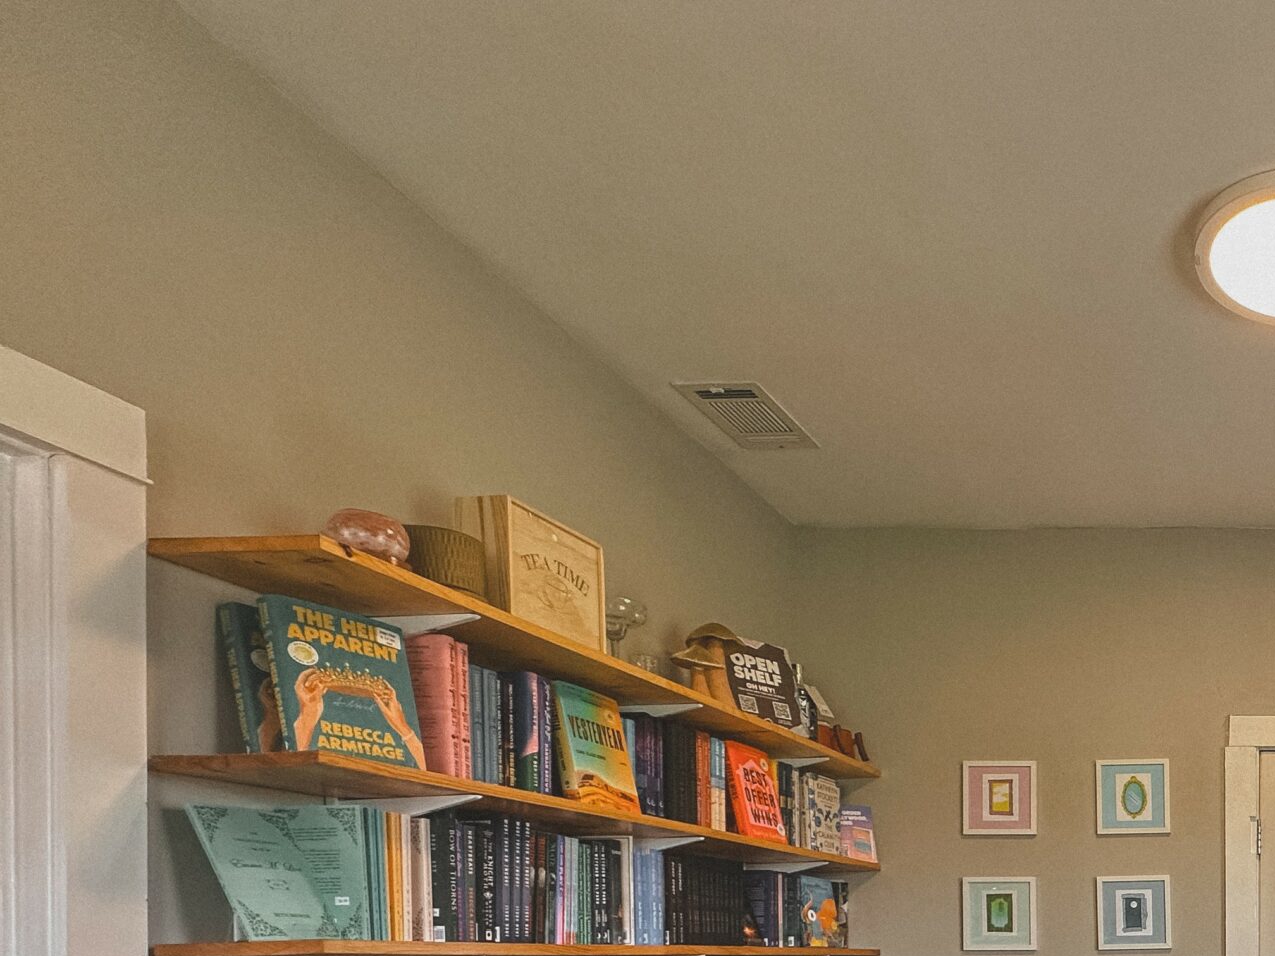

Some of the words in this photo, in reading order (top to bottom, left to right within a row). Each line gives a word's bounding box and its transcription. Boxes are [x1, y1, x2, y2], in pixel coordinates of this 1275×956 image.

[521, 553, 552, 571] TEA
[554, 559, 590, 597] TIME
[292, 605, 336, 631] THE
[340, 617, 378, 641] HEI
[287, 623, 399, 664] APPARENT
[729, 652, 780, 675] OPEN
[733, 666, 782, 687] SHELF
[759, 684, 776, 694] HEY!
[319, 719, 396, 746] REBECCA
[567, 714, 625, 752] YESTERYEAR
[317, 735, 405, 761] ARMITAGE
[743, 767, 767, 786] BEST
[744, 787, 776, 808] OFFER
[751, 809, 779, 827] WINS
